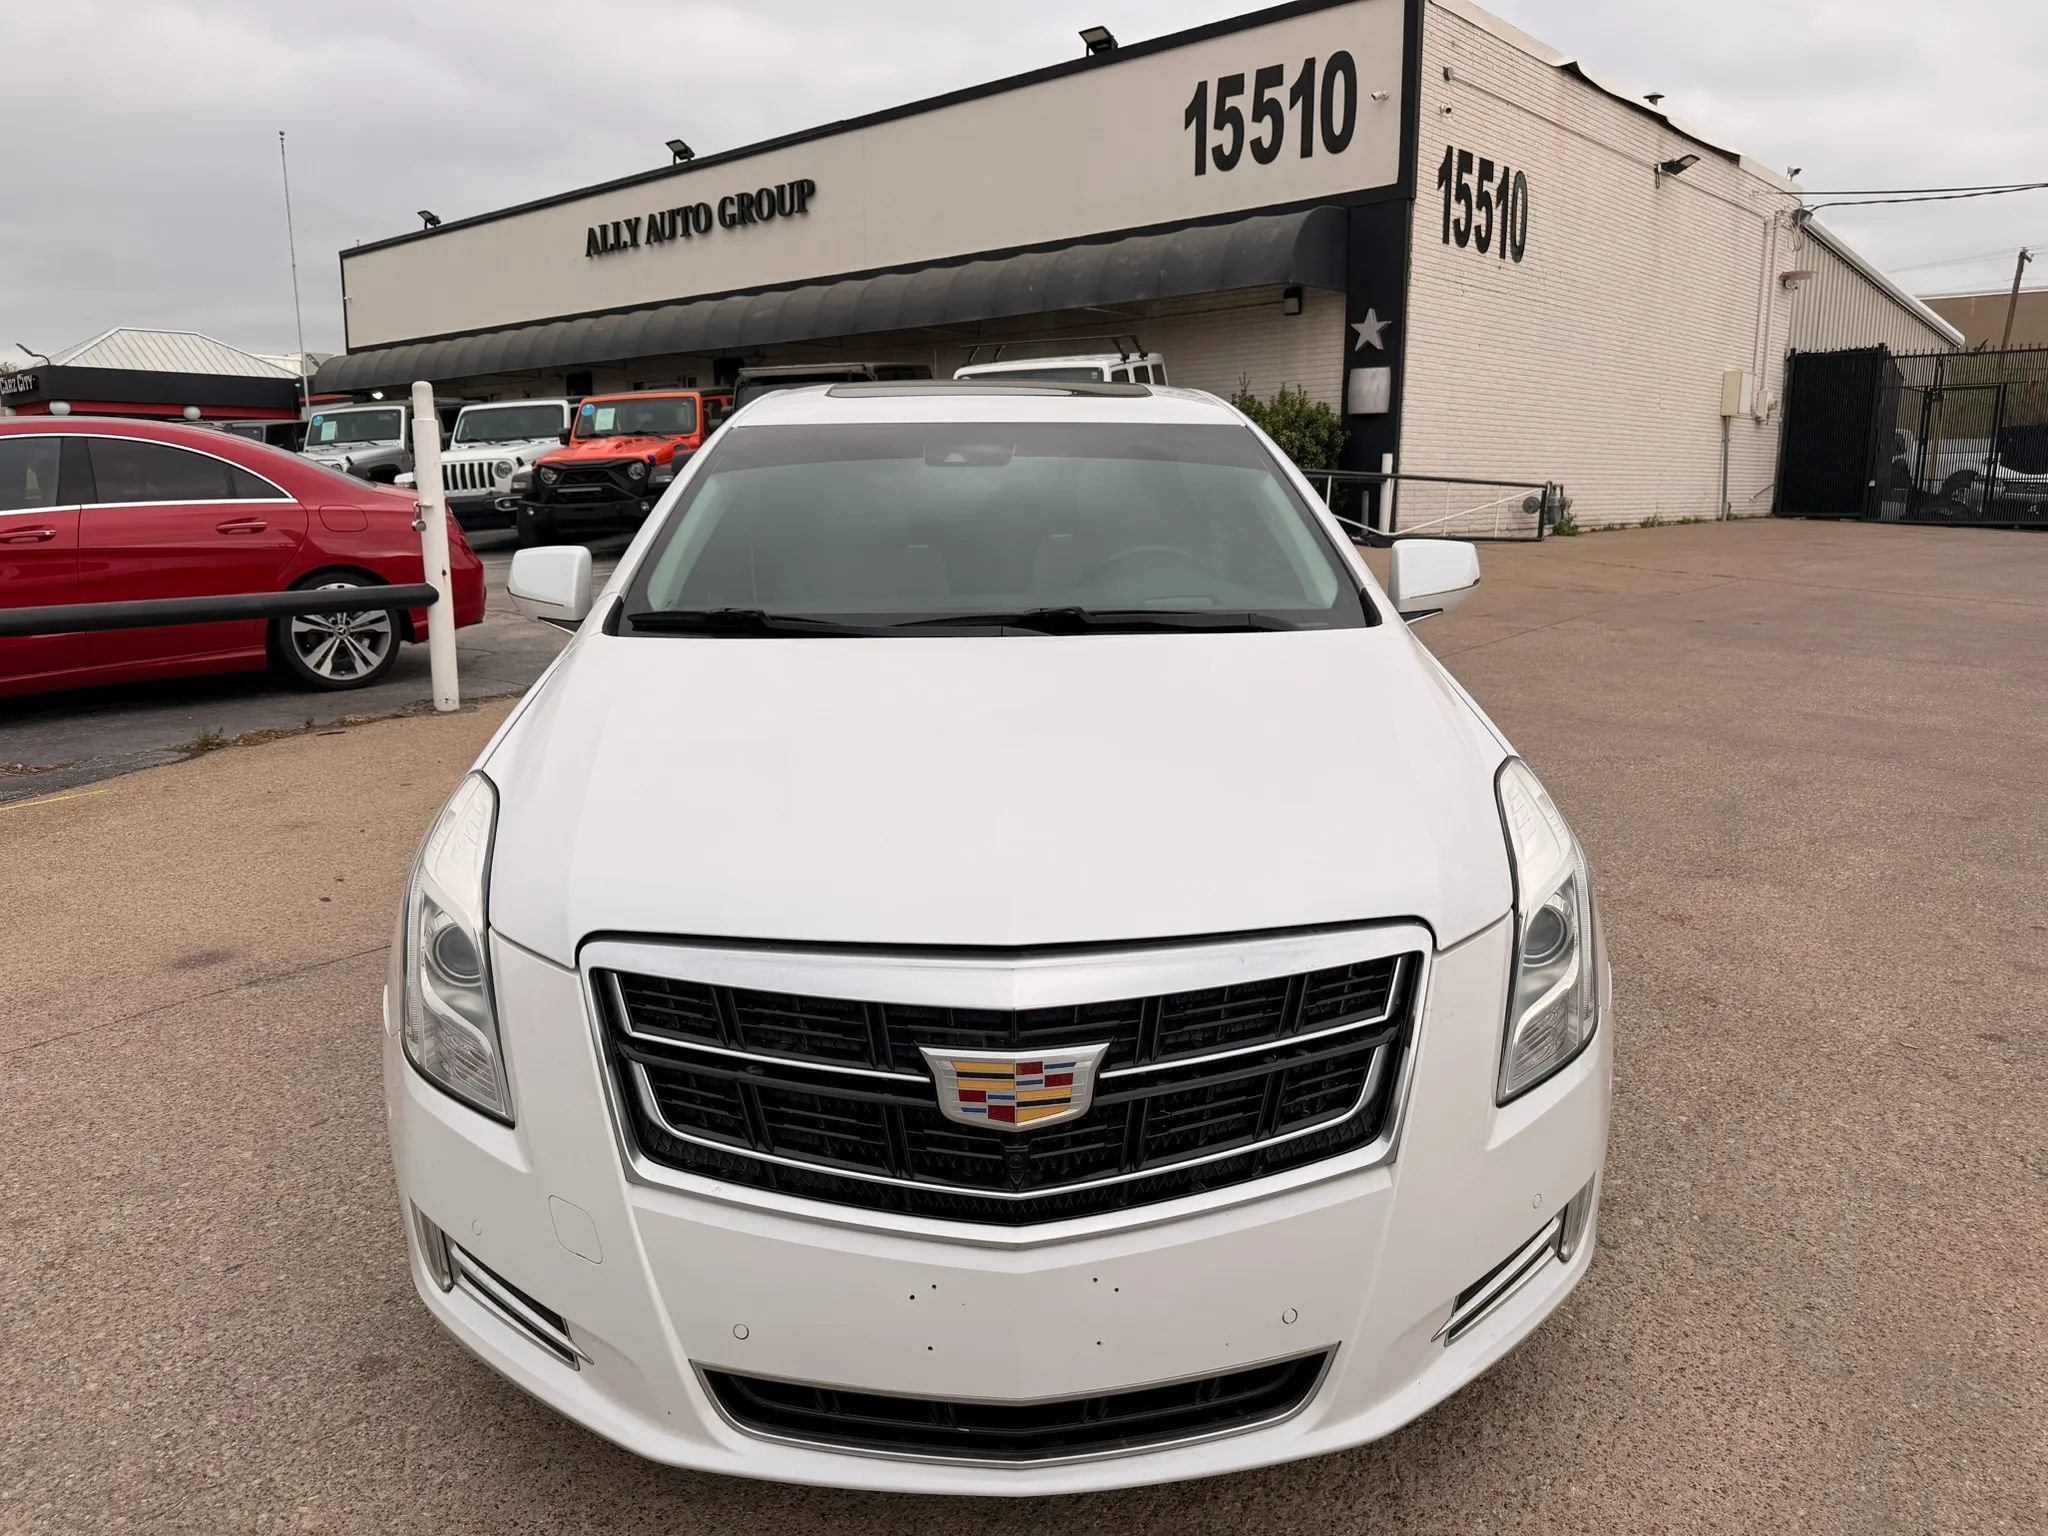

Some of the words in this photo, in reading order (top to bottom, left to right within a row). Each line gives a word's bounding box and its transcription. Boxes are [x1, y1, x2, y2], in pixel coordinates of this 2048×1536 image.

[1184, 50, 1357, 176] 15510
[585, 217, 641, 257] ALLY
[645, 202, 712, 245] AUTO
[717, 179, 816, 229] GROUP
[1438, 145, 1528, 263] 15510
